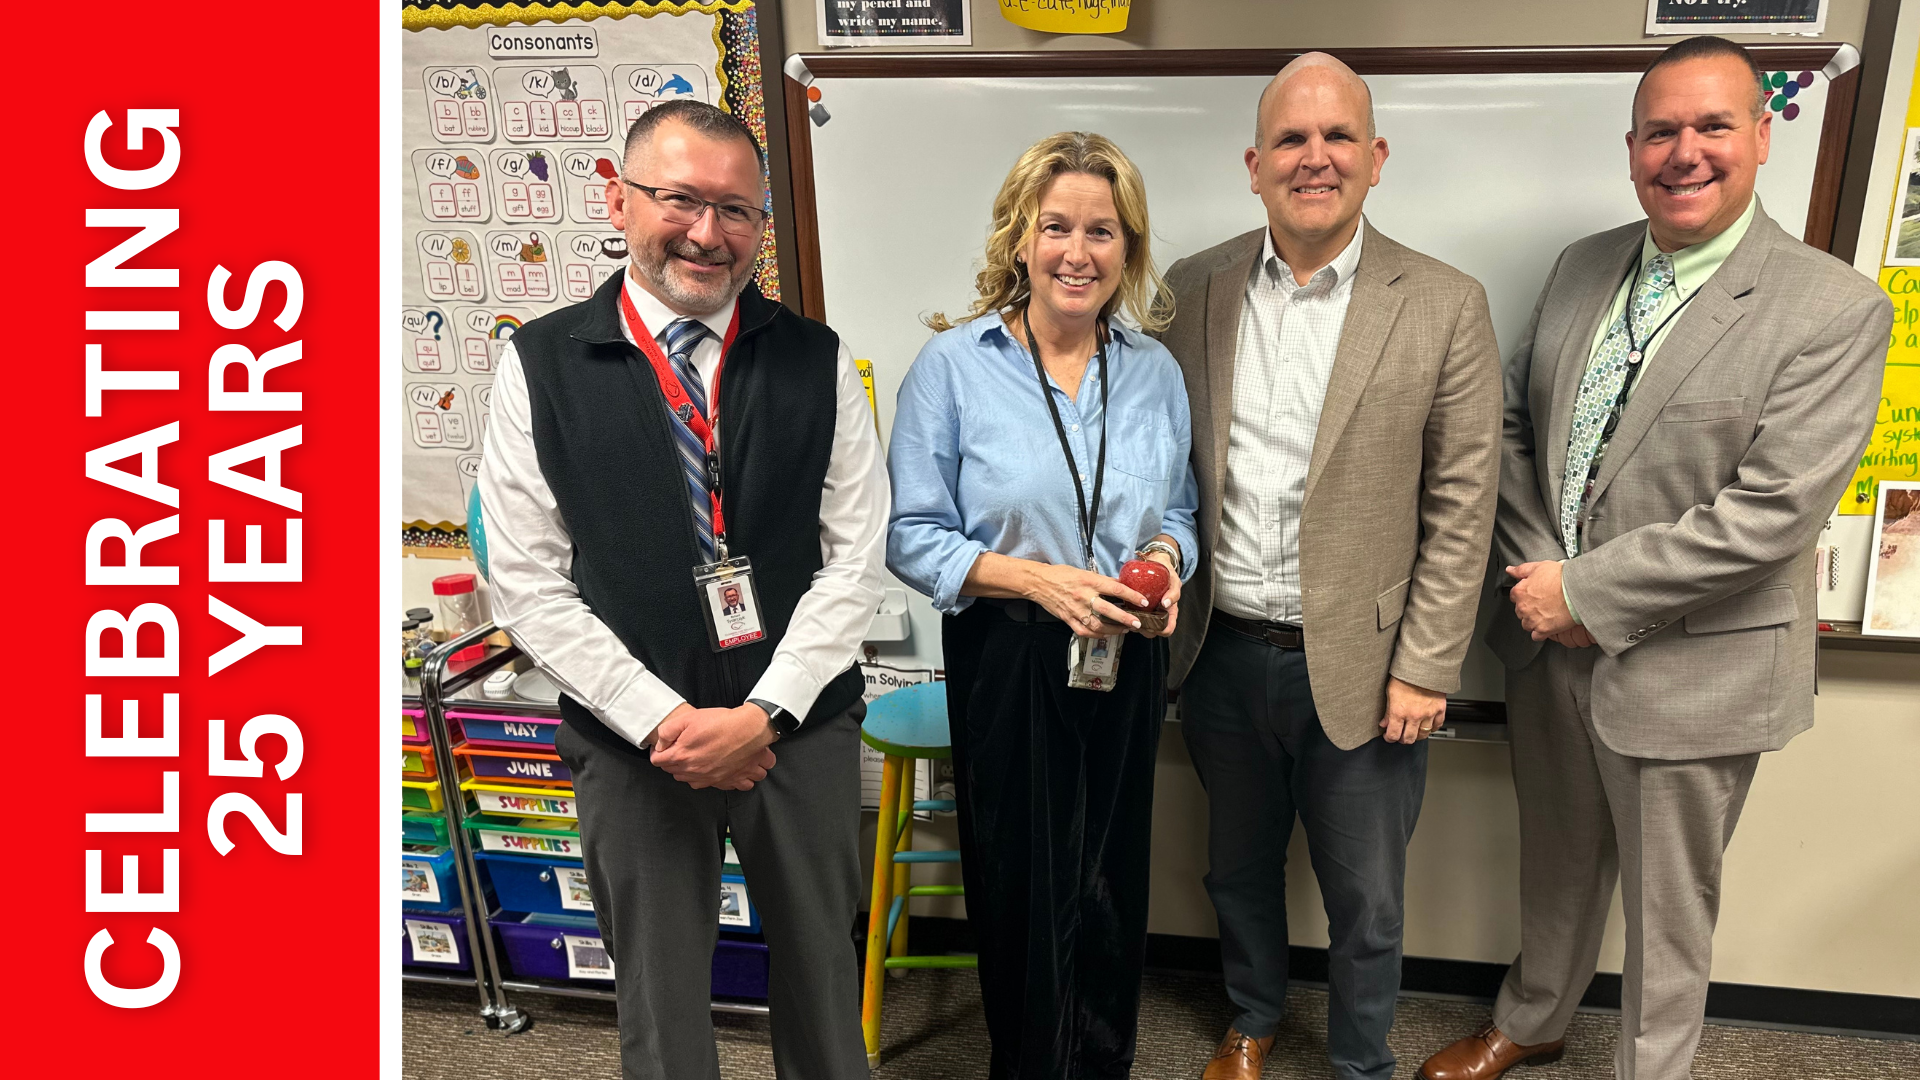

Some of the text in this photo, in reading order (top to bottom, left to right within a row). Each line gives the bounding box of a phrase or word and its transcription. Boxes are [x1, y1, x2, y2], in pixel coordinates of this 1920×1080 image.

[905, 0, 931, 8] and
[838, 15, 943, 29] write my name.
[491, 33, 594, 51] Consonants
[435, 75, 456, 89] /b/
[529, 75, 549, 89] /k/
[635, 74, 656, 88] /d/
[443, 104, 452, 116] b
[469, 106, 481, 116] bb
[513, 107, 520, 116] c
[539, 104, 546, 115] k
[562, 109, 574, 117] cc
[587, 105, 598, 115] ck
[634, 105, 641, 115] d
[444, 124, 455, 132] bat
[539, 124, 550, 133] kid
[560, 125, 580, 134] hiccup
[586, 125, 605, 133] black
[430, 157, 452, 171] /f/
[503, 158, 524, 173] /g/
[571, 158, 591, 171] /h/
[439, 188, 445, 199] f
[461, 187, 472, 198] ff
[511, 188, 519, 198] g
[535, 189, 547, 199] gg
[592, 188, 600, 200] h
[461, 204, 477, 213] stuff
[511, 204, 525, 213] gift
[591, 205, 604, 215] hat
[495, 240, 518, 252] /m/
[576, 241, 596, 252] /n/
[528, 269, 544, 278] mm
[598, 270, 609, 278] nn
[1887, 269, 1920, 295] Ca
[463, 285, 475, 293] bell
[506, 285, 521, 293] mad
[402, 315, 425, 328] /qu/
[472, 315, 491, 326] /r/
[422, 345, 433, 353] qu
[422, 359, 435, 368] quit
[416, 390, 435, 402] /v/
[425, 432, 437, 440] vet
[1859, 447, 1918, 478] writing
[725, 632, 758, 645] EMPLOYEE
[503, 722, 539, 738] MAY
[506, 761, 553, 777] JUNE
[498, 795, 569, 814] SUPPLIES
[501, 835, 571, 853] SUPPLIES
